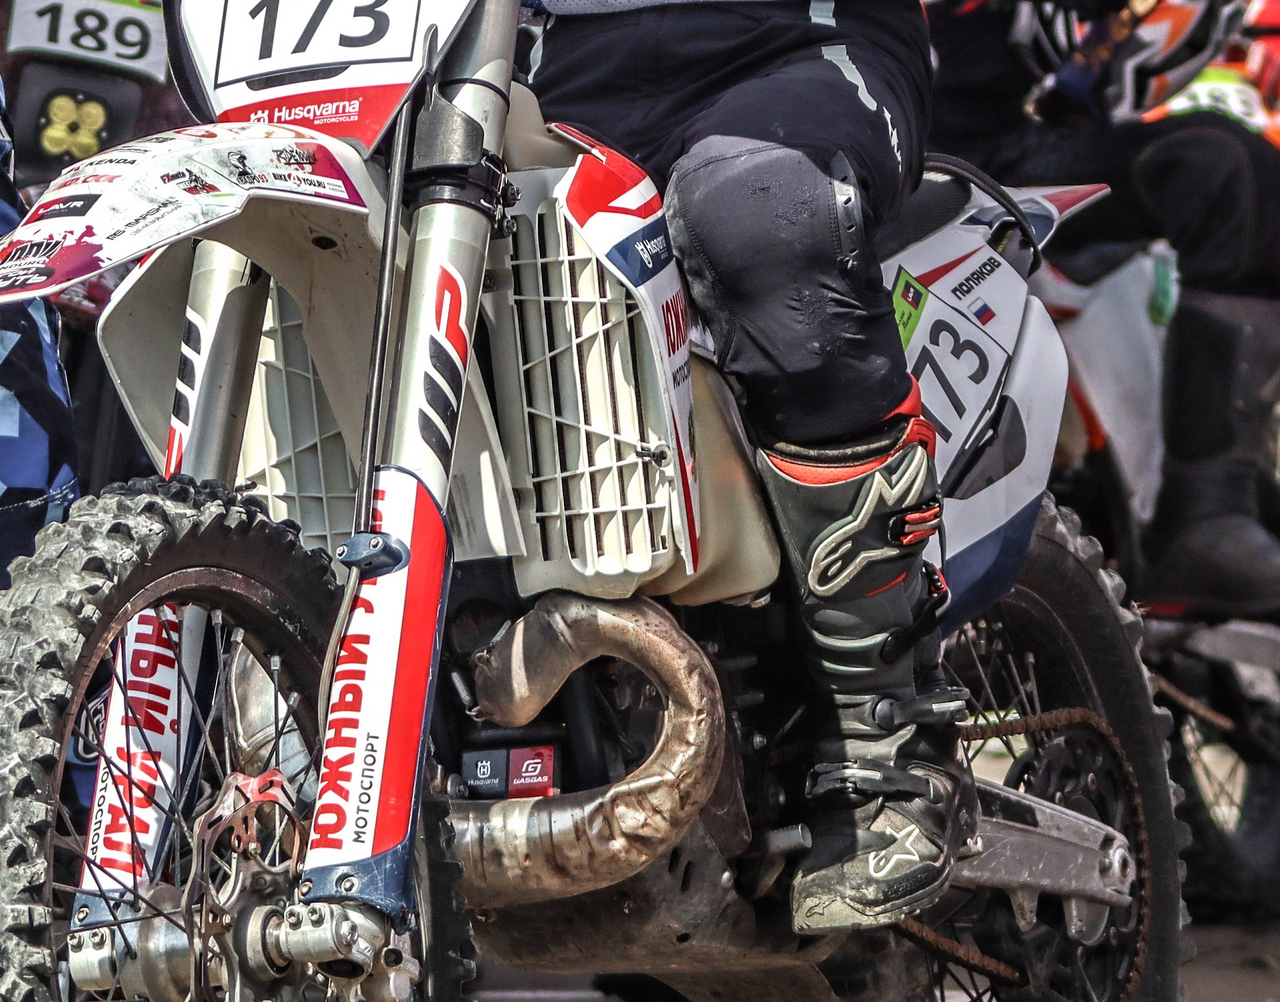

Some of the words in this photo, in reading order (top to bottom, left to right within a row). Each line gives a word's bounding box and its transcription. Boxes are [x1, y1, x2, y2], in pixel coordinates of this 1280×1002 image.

[36, 2, 152, 60] 189
[273, 99, 359, 123] Husqvarna
[313, 115, 359, 125] MOTORCYCLES
[85, 158, 137, 168] KENDA
[37, 200, 85, 215] LAVR
[950, 255, 1003, 301] ПОЛЯКОВ
[308, 633, 371, 851] ЮЖНЫЙ
[352, 732, 380, 845] МОТОСПОРТ
[467, 777, 499, 786] Husqvarna
[513, 775, 549, 785] GASGAS
